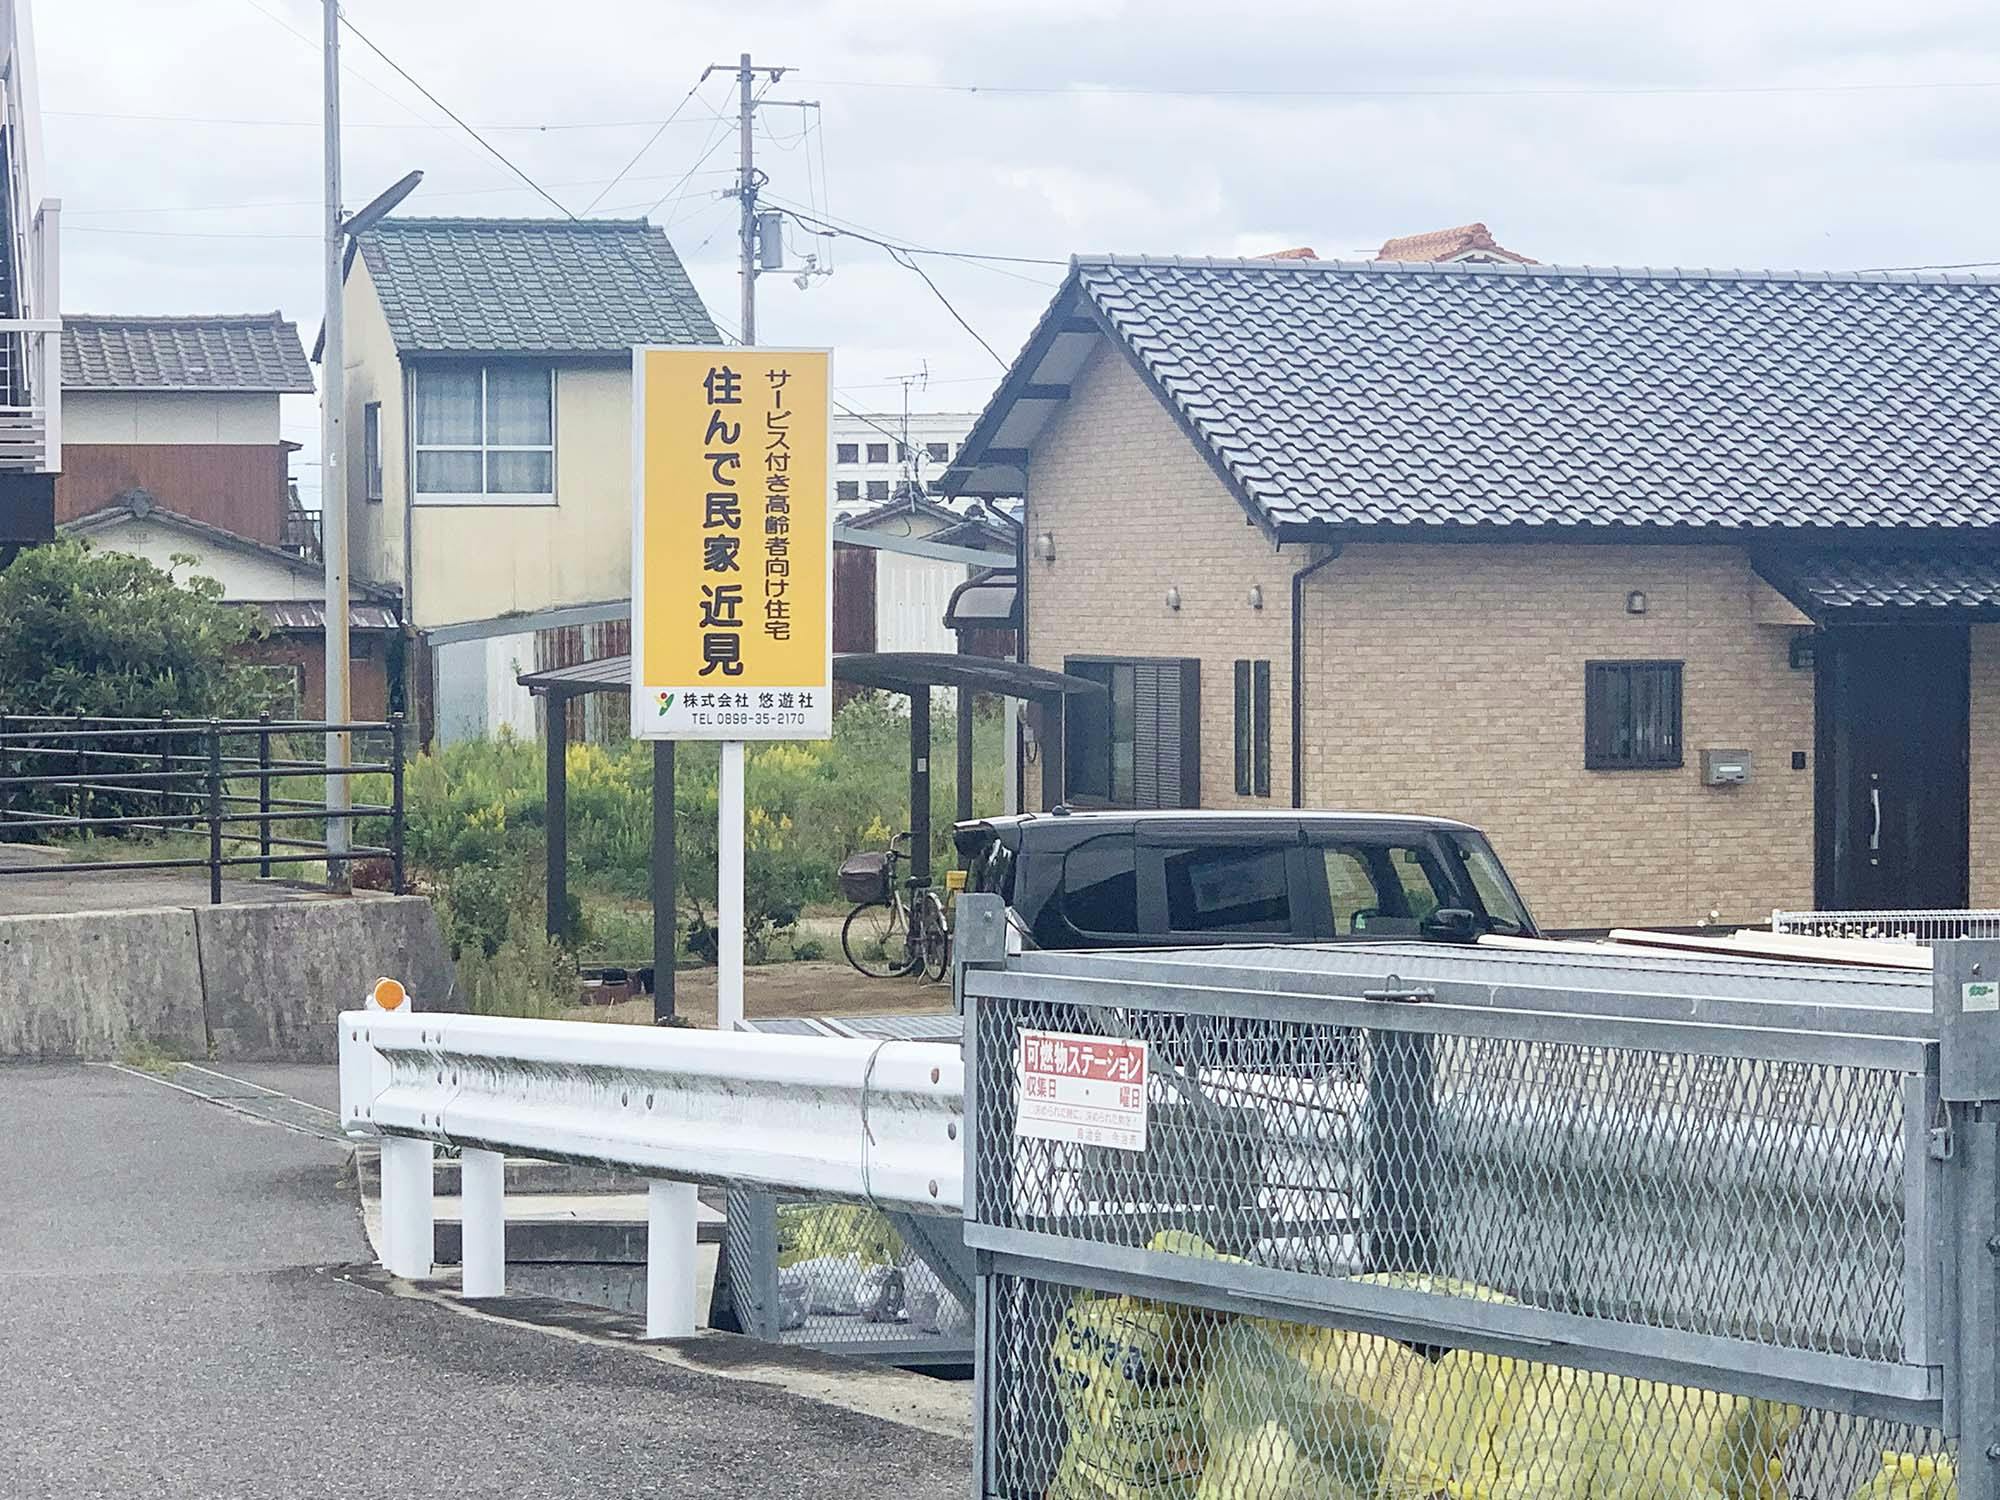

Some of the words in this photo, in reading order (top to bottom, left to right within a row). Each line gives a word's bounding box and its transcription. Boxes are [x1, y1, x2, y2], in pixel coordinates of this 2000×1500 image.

[702, 366, 743, 573] 住んで民家
[764, 369, 792, 640] サービス付き高齢者向け住宅
[698, 584, 743, 676] 近見
[683, 692, 749, 708] 株式会社
[758, 692, 814, 708] 悠遊社
[692, 713, 713, 725] TEL
[716, 713, 805, 725] 0898-35-2170
[1026, 1039, 1142, 1080] 可燃物ステーション
[1026, 1076, 1057, 1098] 収集日
[1119, 1086, 1140, 1108] 曜日
